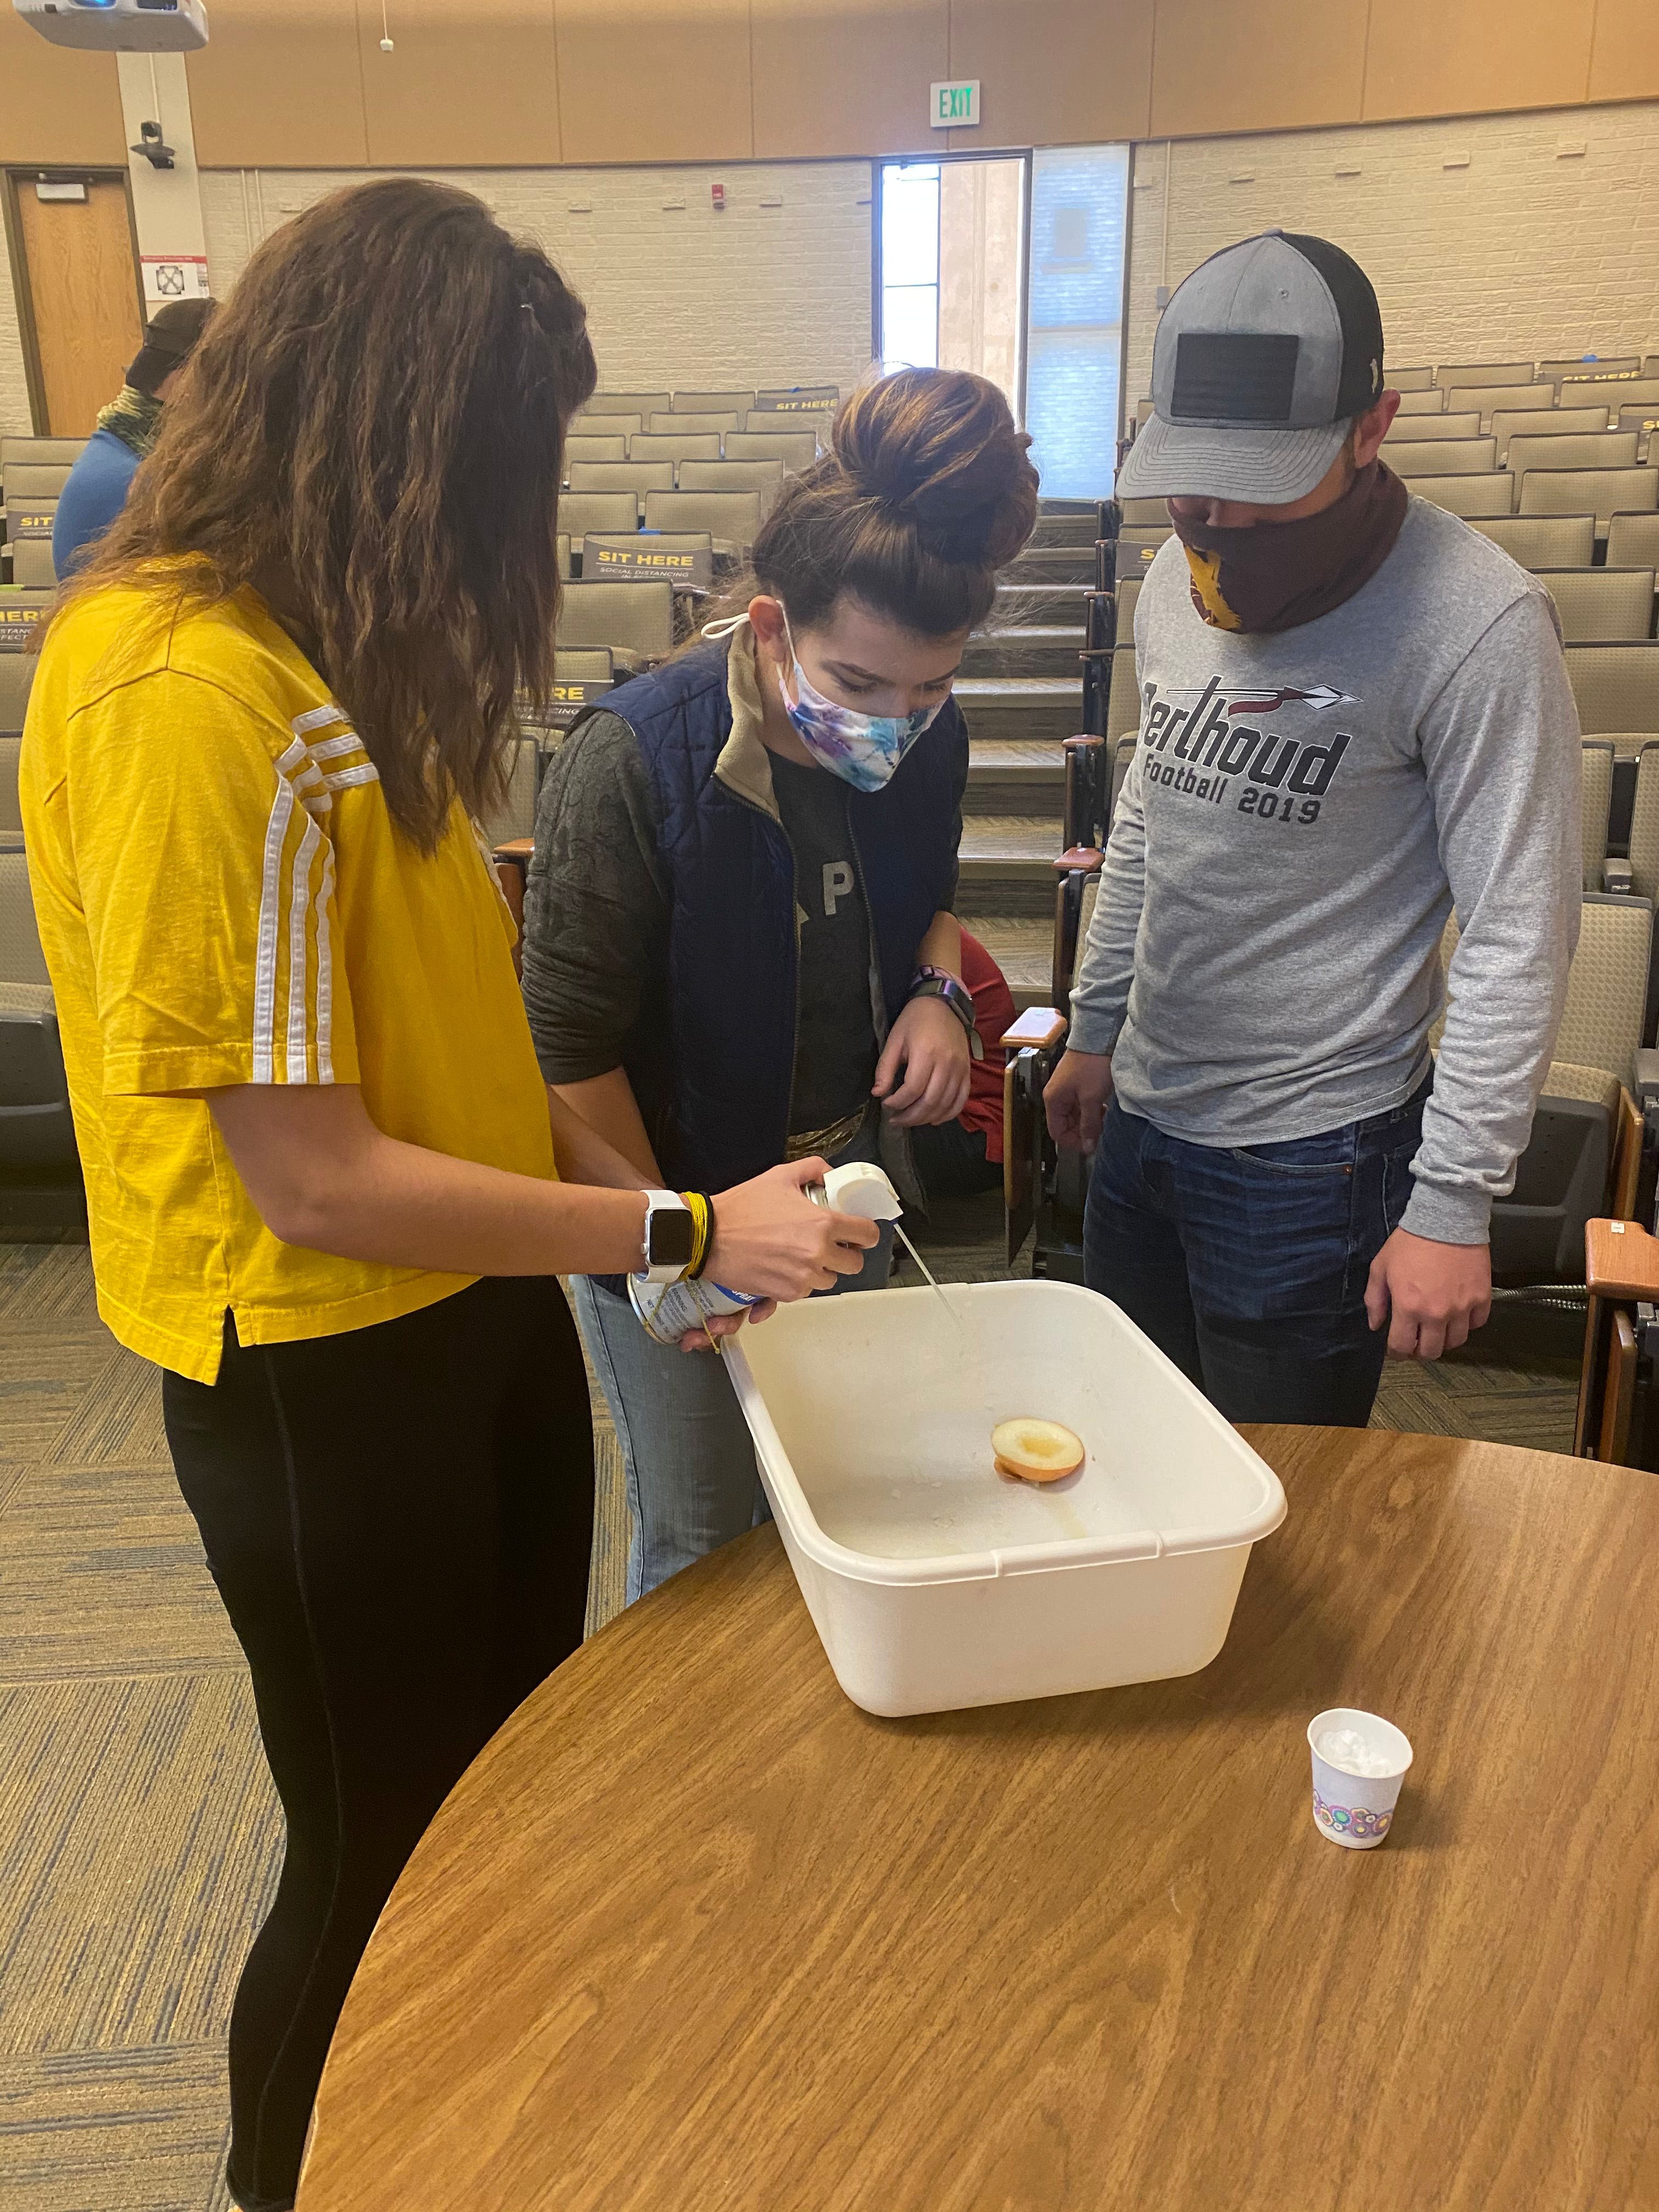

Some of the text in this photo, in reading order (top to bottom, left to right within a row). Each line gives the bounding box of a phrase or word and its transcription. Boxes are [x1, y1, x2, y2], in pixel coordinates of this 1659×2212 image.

[939, 87, 972, 118] EXIT
[801, 398, 838, 409] HERE
[20, 517, 53, 527] SIT
[598, 551, 694, 567] SIT HERE
[600, 566, 631, 575] SOCIAL
[634, 569, 690, 578] DISTANCING
[1143, 753, 1322, 825] Football 2019
